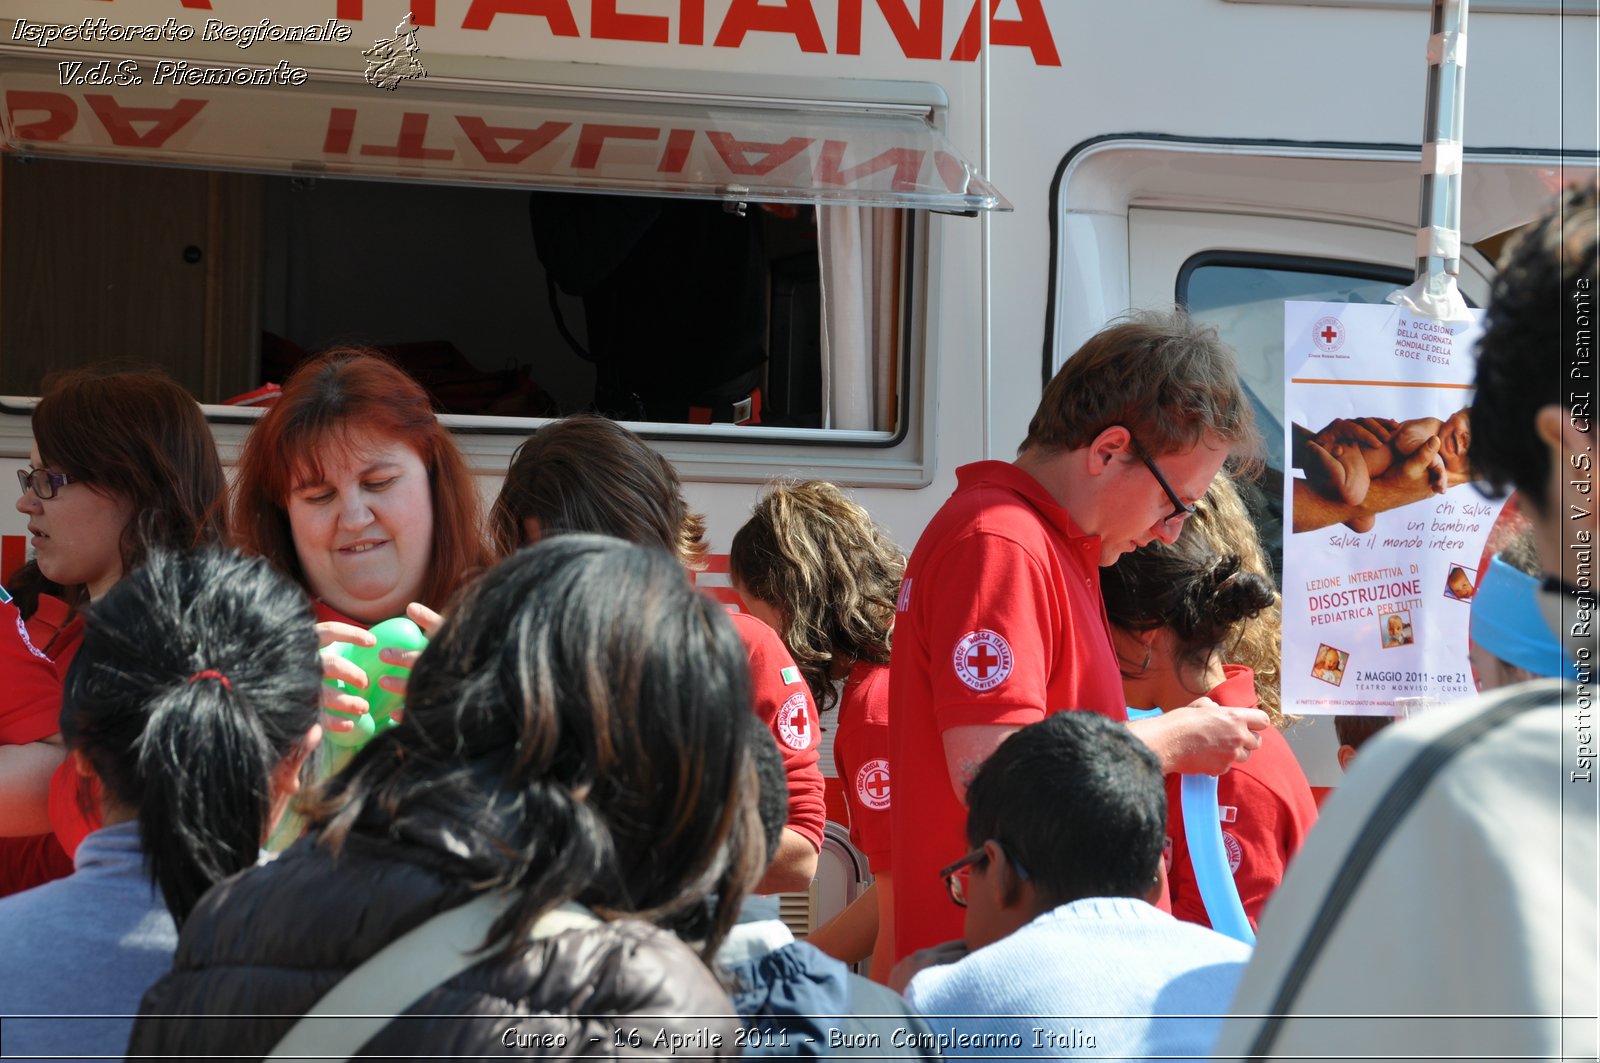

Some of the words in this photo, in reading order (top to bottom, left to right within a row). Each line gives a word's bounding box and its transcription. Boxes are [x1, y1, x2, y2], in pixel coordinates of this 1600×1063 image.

[1412, 321, 1455, 336] OCCASIONE
[1397, 328, 1419, 339] DELLA
[1421, 333, 1452, 346] GIORNATA
[1395, 339, 1430, 352] MONDIALE
[1431, 345, 1451, 355] DELLA
[1394, 349, 1420, 360] CROCE
[1426, 354, 1450, 366] ROSSA
[1436, 501, 1455, 514] chi
[1462, 502, 1492, 517] salva
[1407, 520, 1425, 531] un
[1430, 518, 1480, 533] bambino
[1329, 533, 1361, 549] salva
[1366, 533, 1377, 550] il
[1382, 537, 1423, 549] mondo
[1428, 537, 1465, 551] intero
[1305, 576, 1341, 591] LEZIONE
[1348, 567, 1403, 584] INTERATTIVA
[1410, 563, 1419, 575] DI
[1308, 579, 1422, 612] DISOSTRUZIONE
[1311, 607, 1373, 626] PEDIATRICA
[1378, 602, 1394, 615] PER
[1395, 598, 1423, 612] TUTTI
[955, 644, 966, 672] CROCE
[968, 632, 990, 644] ROSSA
[992, 637, 1010, 671] ITALIANA
[966, 677, 1000, 689] PIONIERI
[1356, 671, 1362, 681] 2
[1365, 671, 1402, 682] MAGGIO
[1405, 672, 1428, 683] 2011
[1437, 674, 1453, 683] ore
[1455, 673, 1467, 683] 21
[1392, 684, 1428, 692] MONVISO
